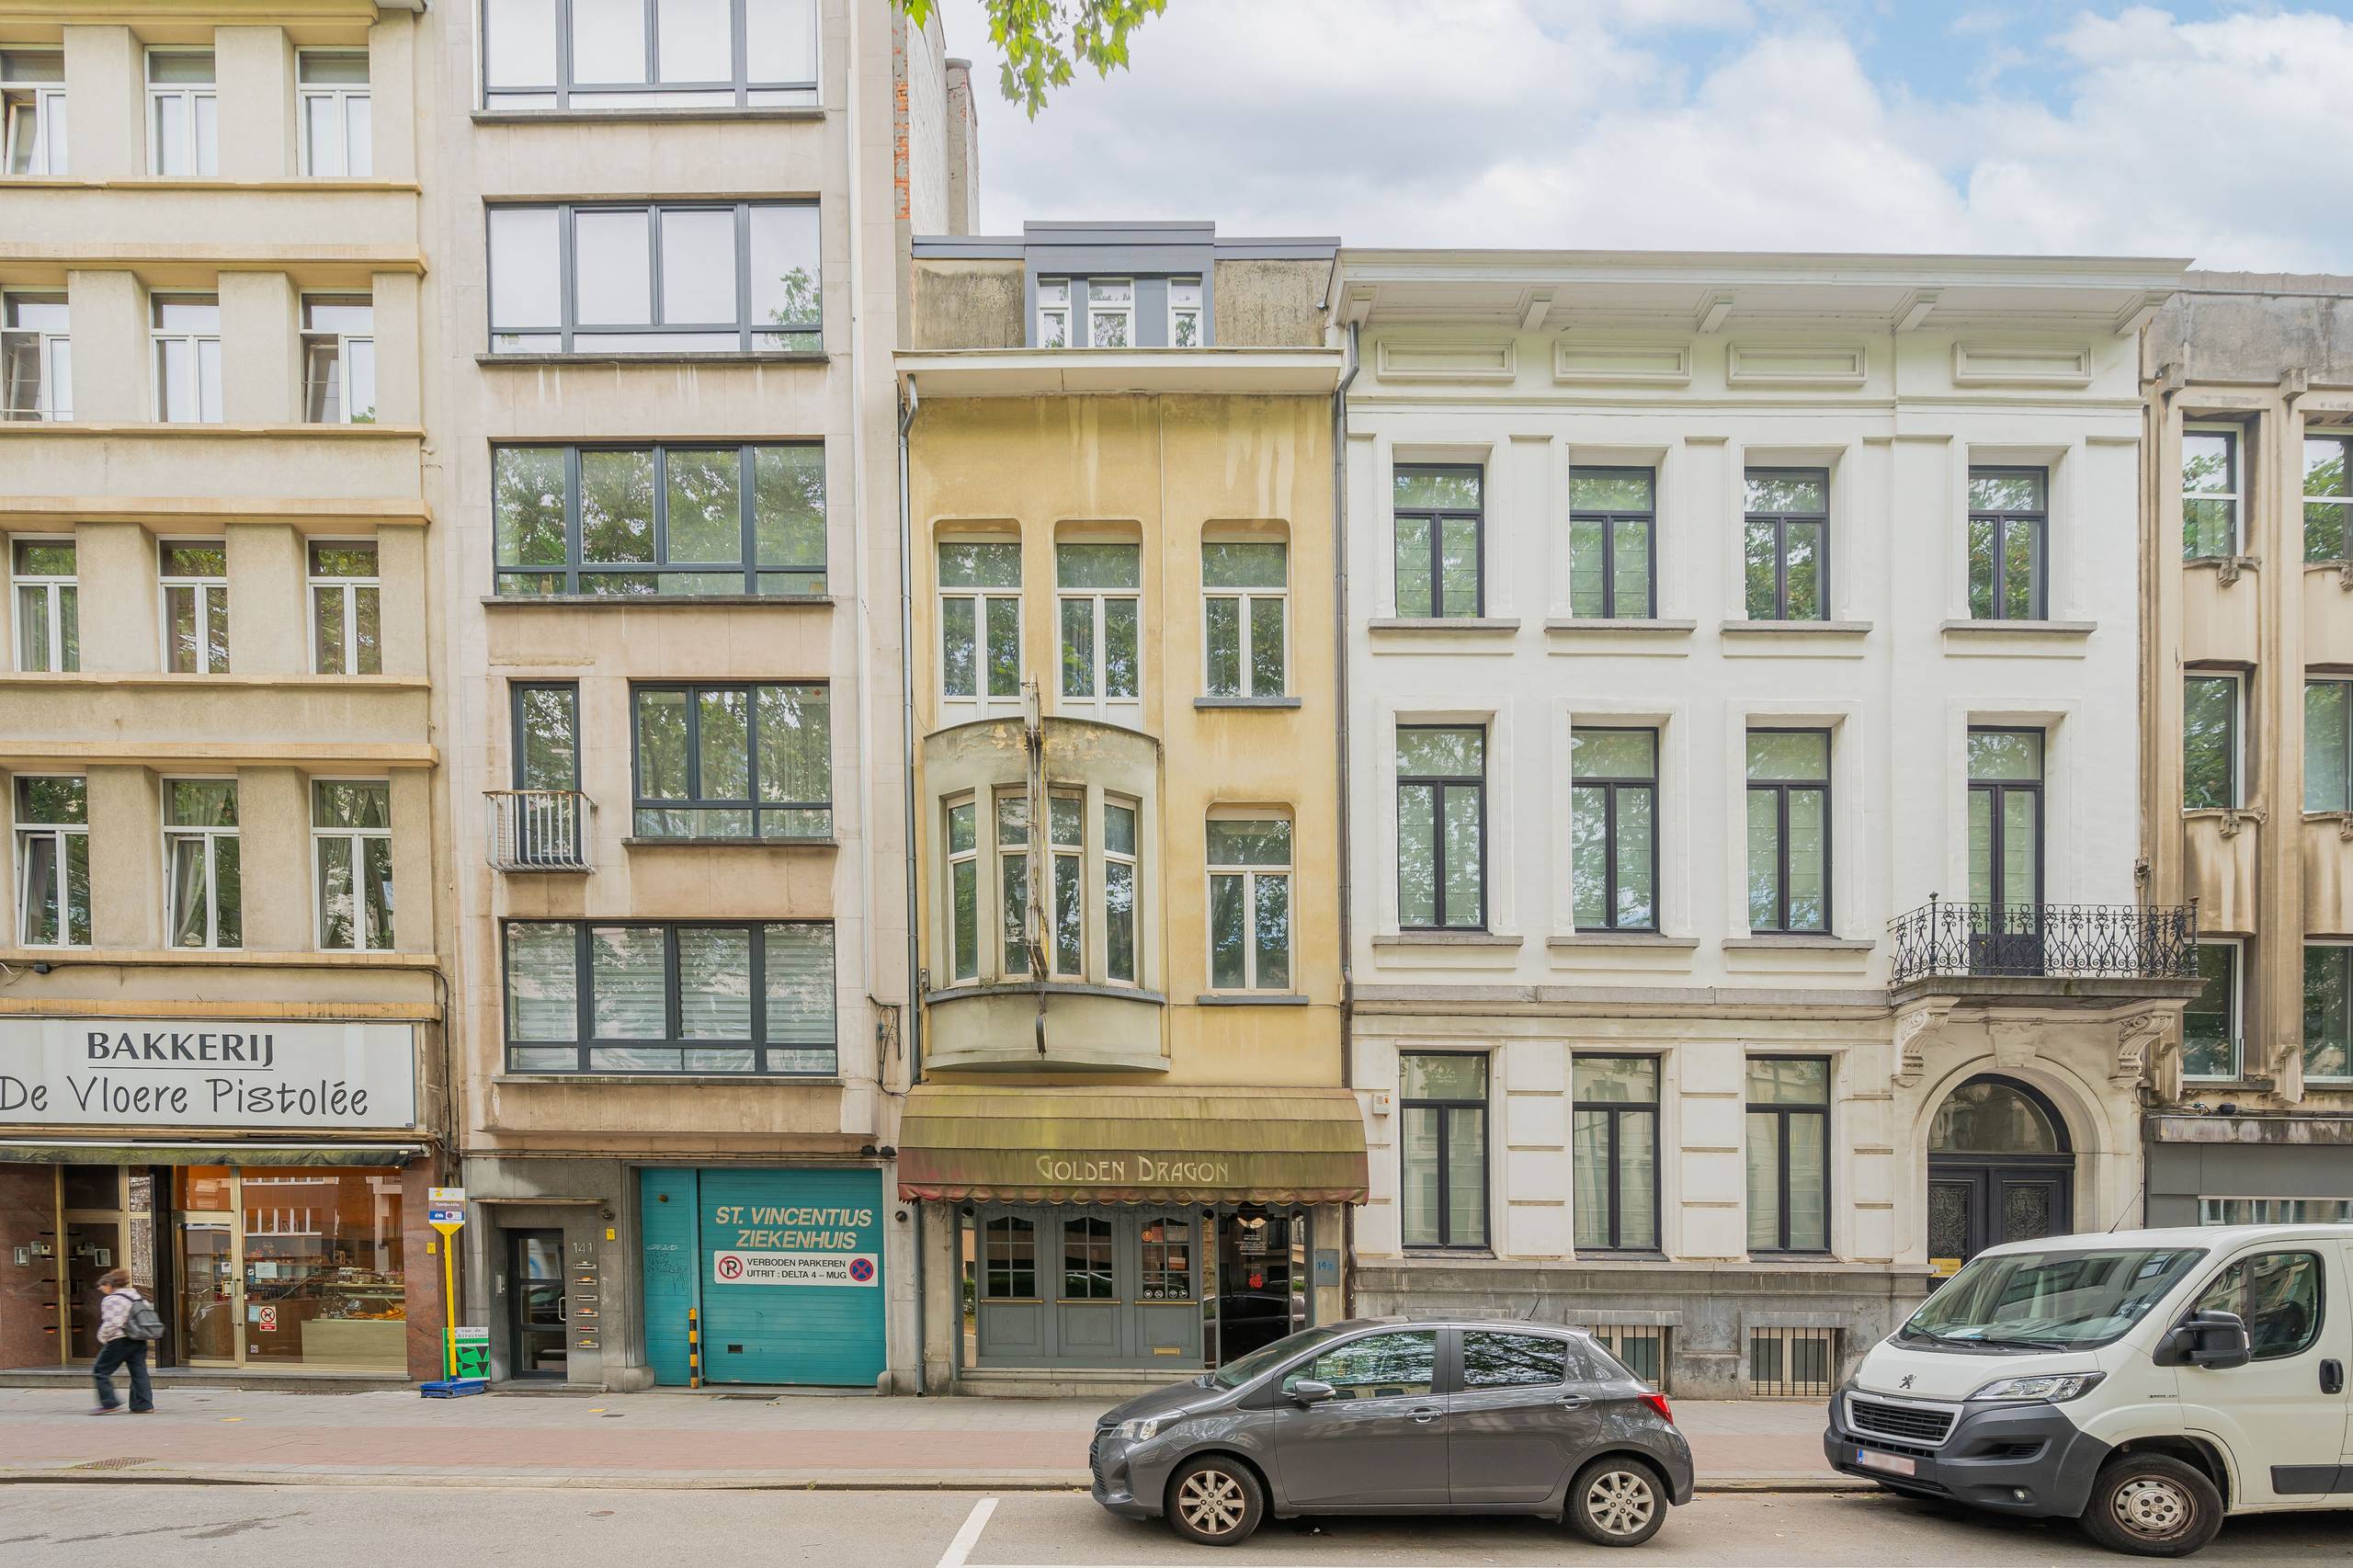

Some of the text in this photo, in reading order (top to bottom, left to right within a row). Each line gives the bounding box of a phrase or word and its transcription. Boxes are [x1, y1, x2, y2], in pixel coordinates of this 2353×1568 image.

[87, 1032, 274, 1067] BAKKERIJ
[0, 1075, 369, 1116] De Vloere Pistolée
[1036, 1154, 1229, 1182] GOLDEN DRAGON
[715, 1206, 873, 1227] ST. VINCENTIUS
[573, 1242, 593, 1254] 141
[735, 1230, 857, 1250] ZIEKENHUIS
[746, 1258, 846, 1267] VERBODEN PARKEREN
[781, 1270, 808, 1278] DELTA
[826, 1271, 847, 1279] MUG
